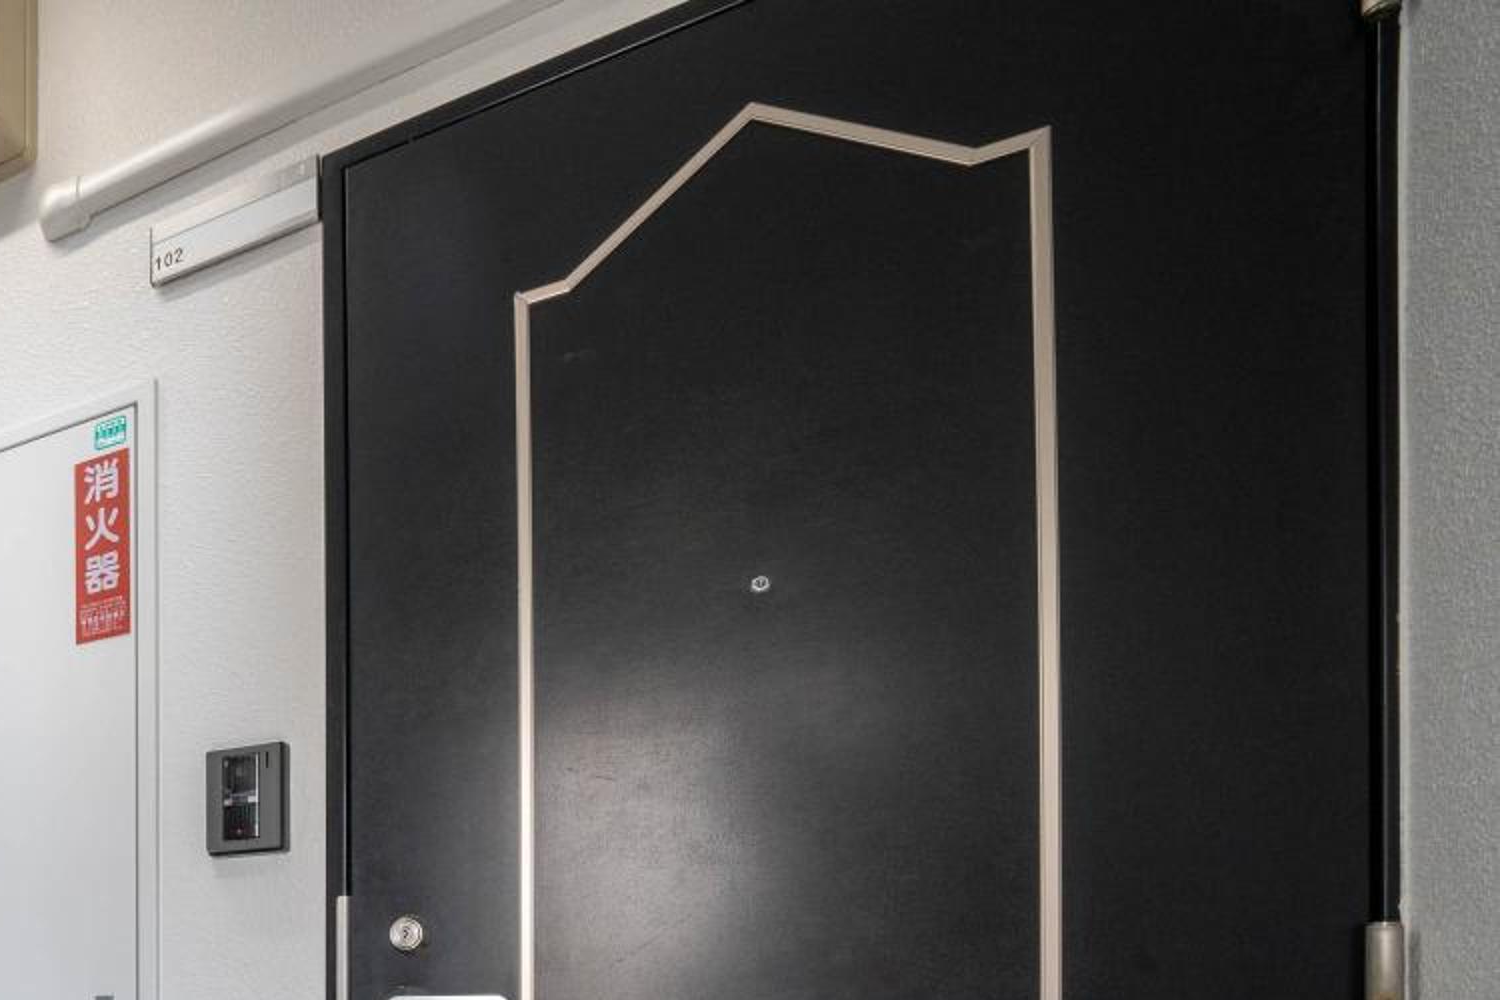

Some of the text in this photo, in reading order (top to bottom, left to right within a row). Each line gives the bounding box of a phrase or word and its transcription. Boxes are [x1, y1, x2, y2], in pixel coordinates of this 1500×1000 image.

[155, 247, 184, 271] 102
[84, 457, 120, 596] 消火器
